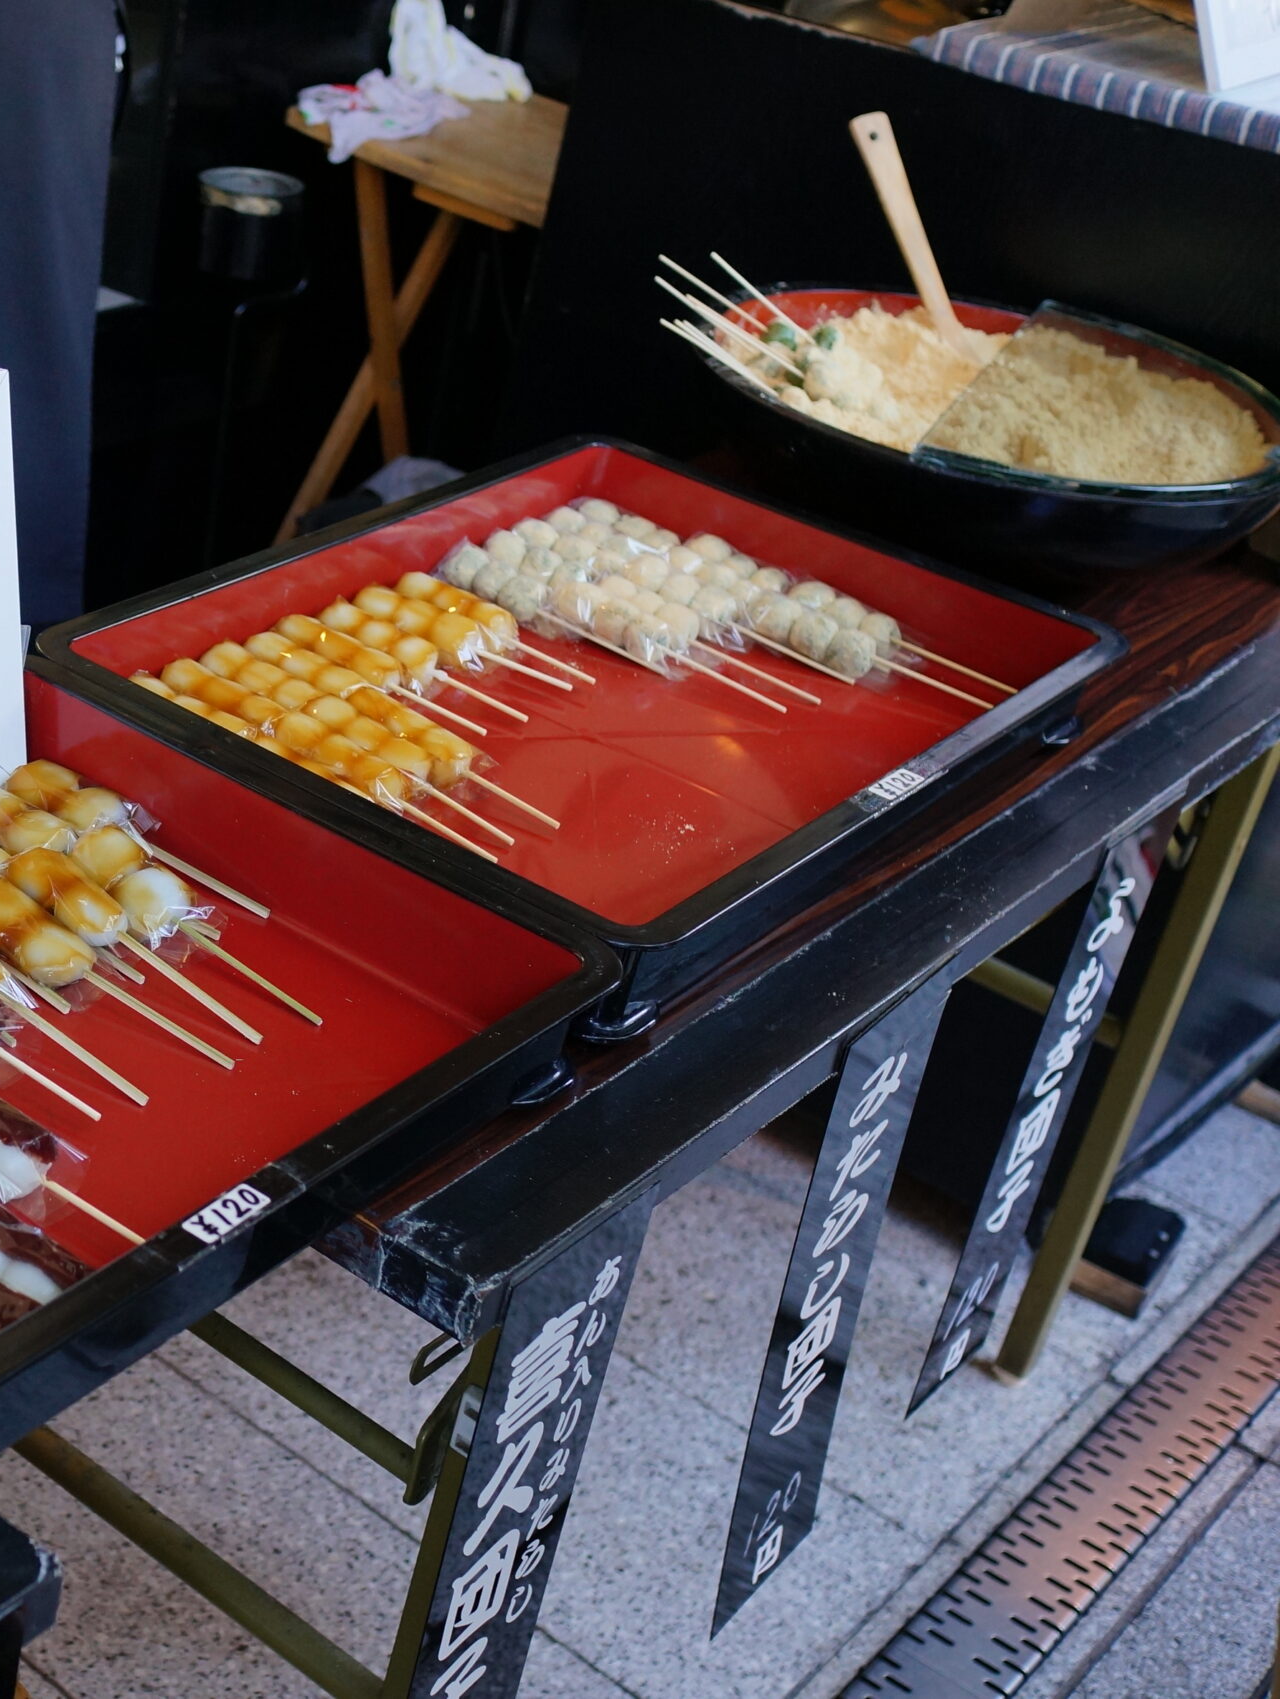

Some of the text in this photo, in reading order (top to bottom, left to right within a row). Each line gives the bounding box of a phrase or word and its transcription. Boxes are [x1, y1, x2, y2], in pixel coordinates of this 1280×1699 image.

[874, 772, 916, 796] ¥120
[190, 1188, 261, 1236] ¥120
[986, 877, 1136, 1232] よもぎ団子
[770, 1052, 907, 1437] みたらし団子
[506, 1256, 622, 1623] あん入りみたらし
